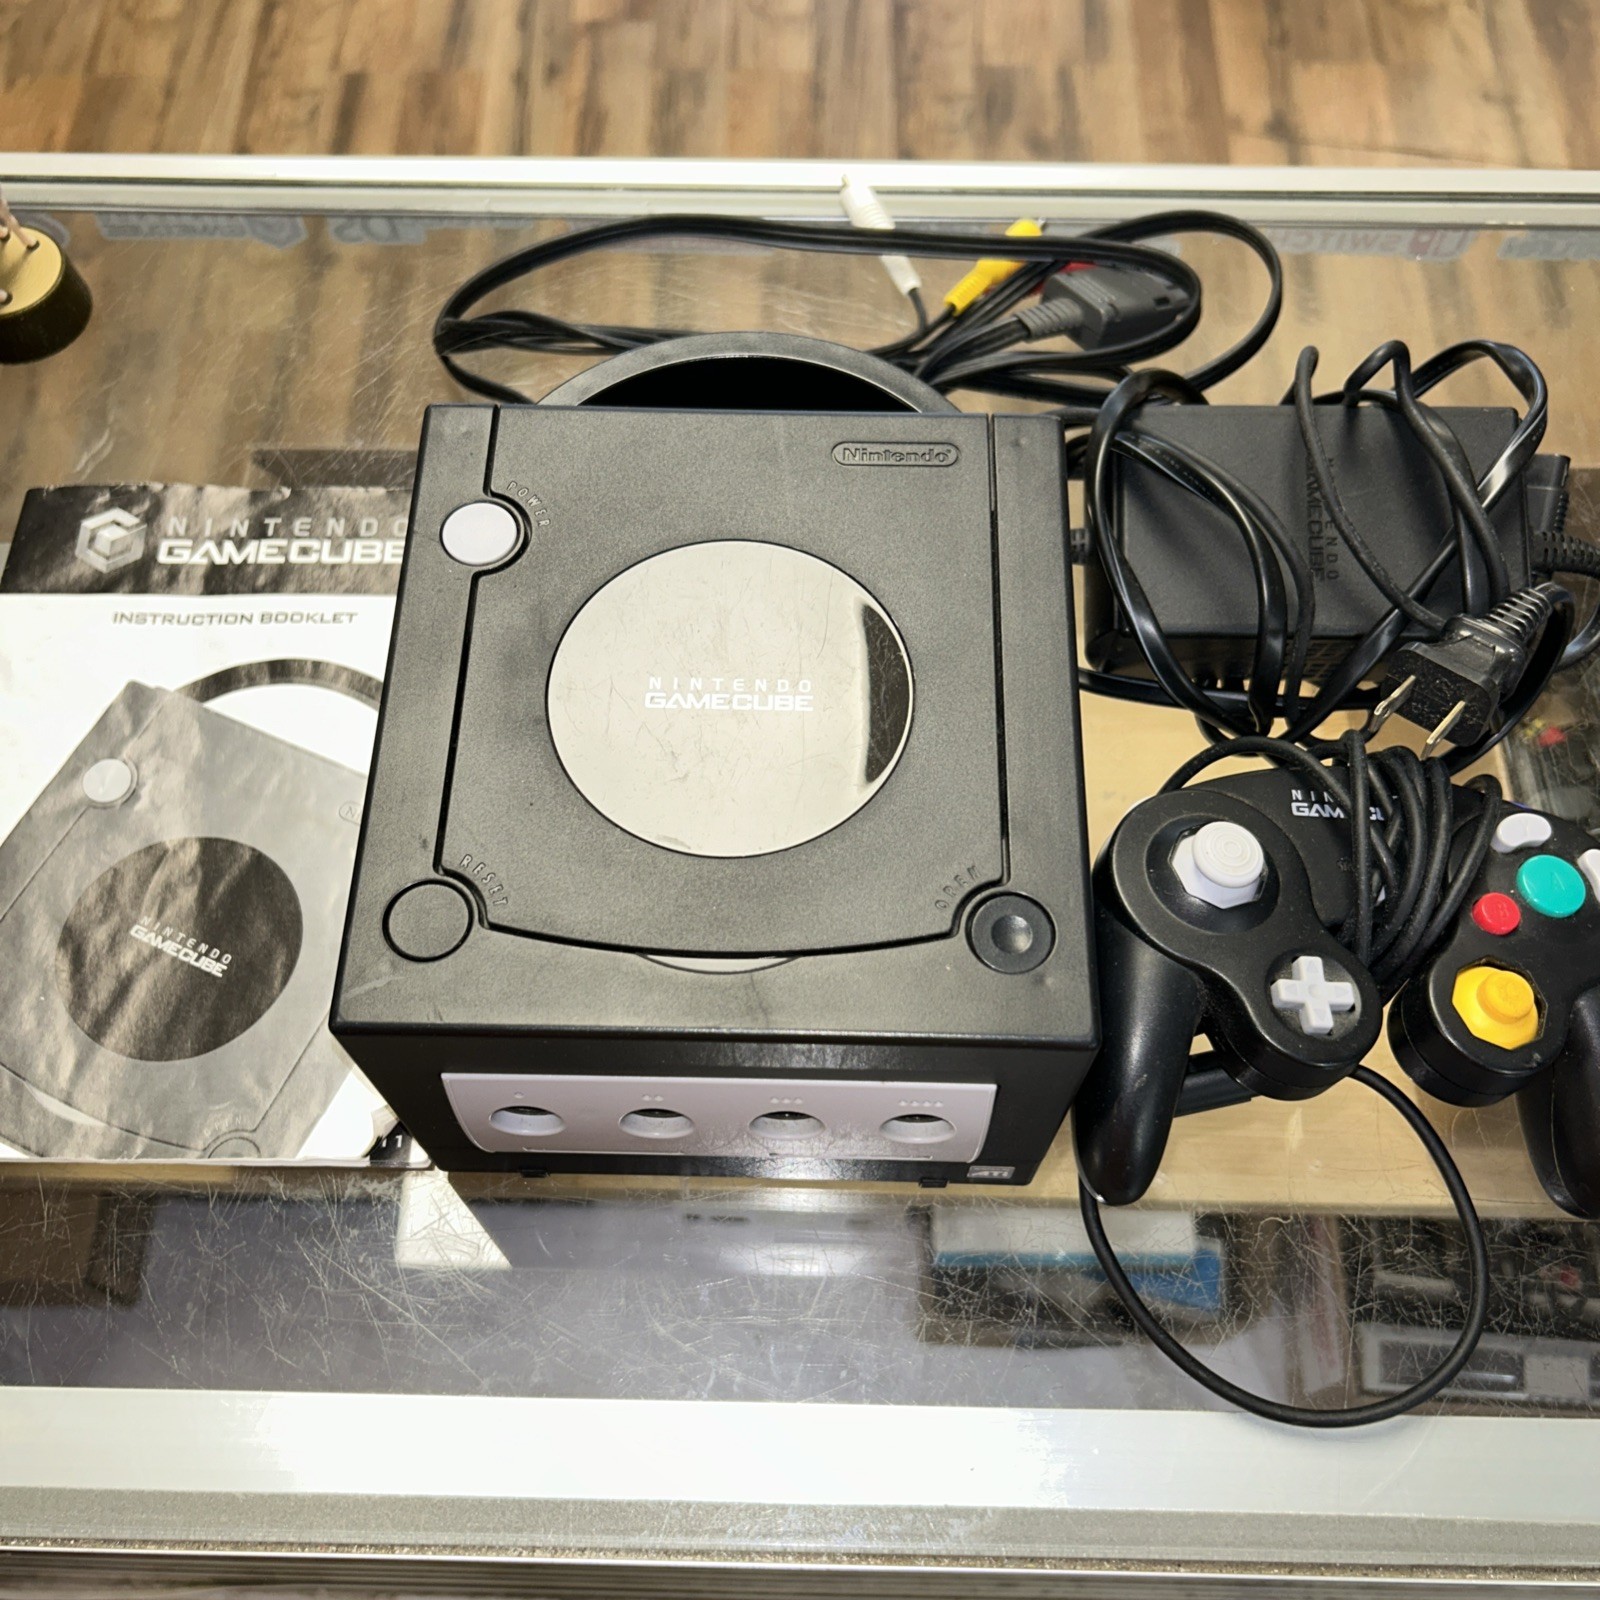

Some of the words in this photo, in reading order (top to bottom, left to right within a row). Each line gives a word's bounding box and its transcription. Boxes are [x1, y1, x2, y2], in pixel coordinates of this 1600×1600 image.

[843, 448, 949, 462] Nintendo
[507, 481, 551, 527] POWER
[167, 516, 409, 537] NINTENDO
[156, 538, 405, 566] GAMECUBE
[112, 611, 254, 626] INSTRUCTION
[260, 611, 359, 625] BOOKLET
[649, 676, 812, 693] NINTENDO
[644, 692, 814, 712] GAMECUBE
[460, 853, 508, 905] RESET
[935, 865, 981, 910] OPEN
[129, 924, 228, 978] GAMECUBE
[140, 915, 233, 965] NINTENDO
